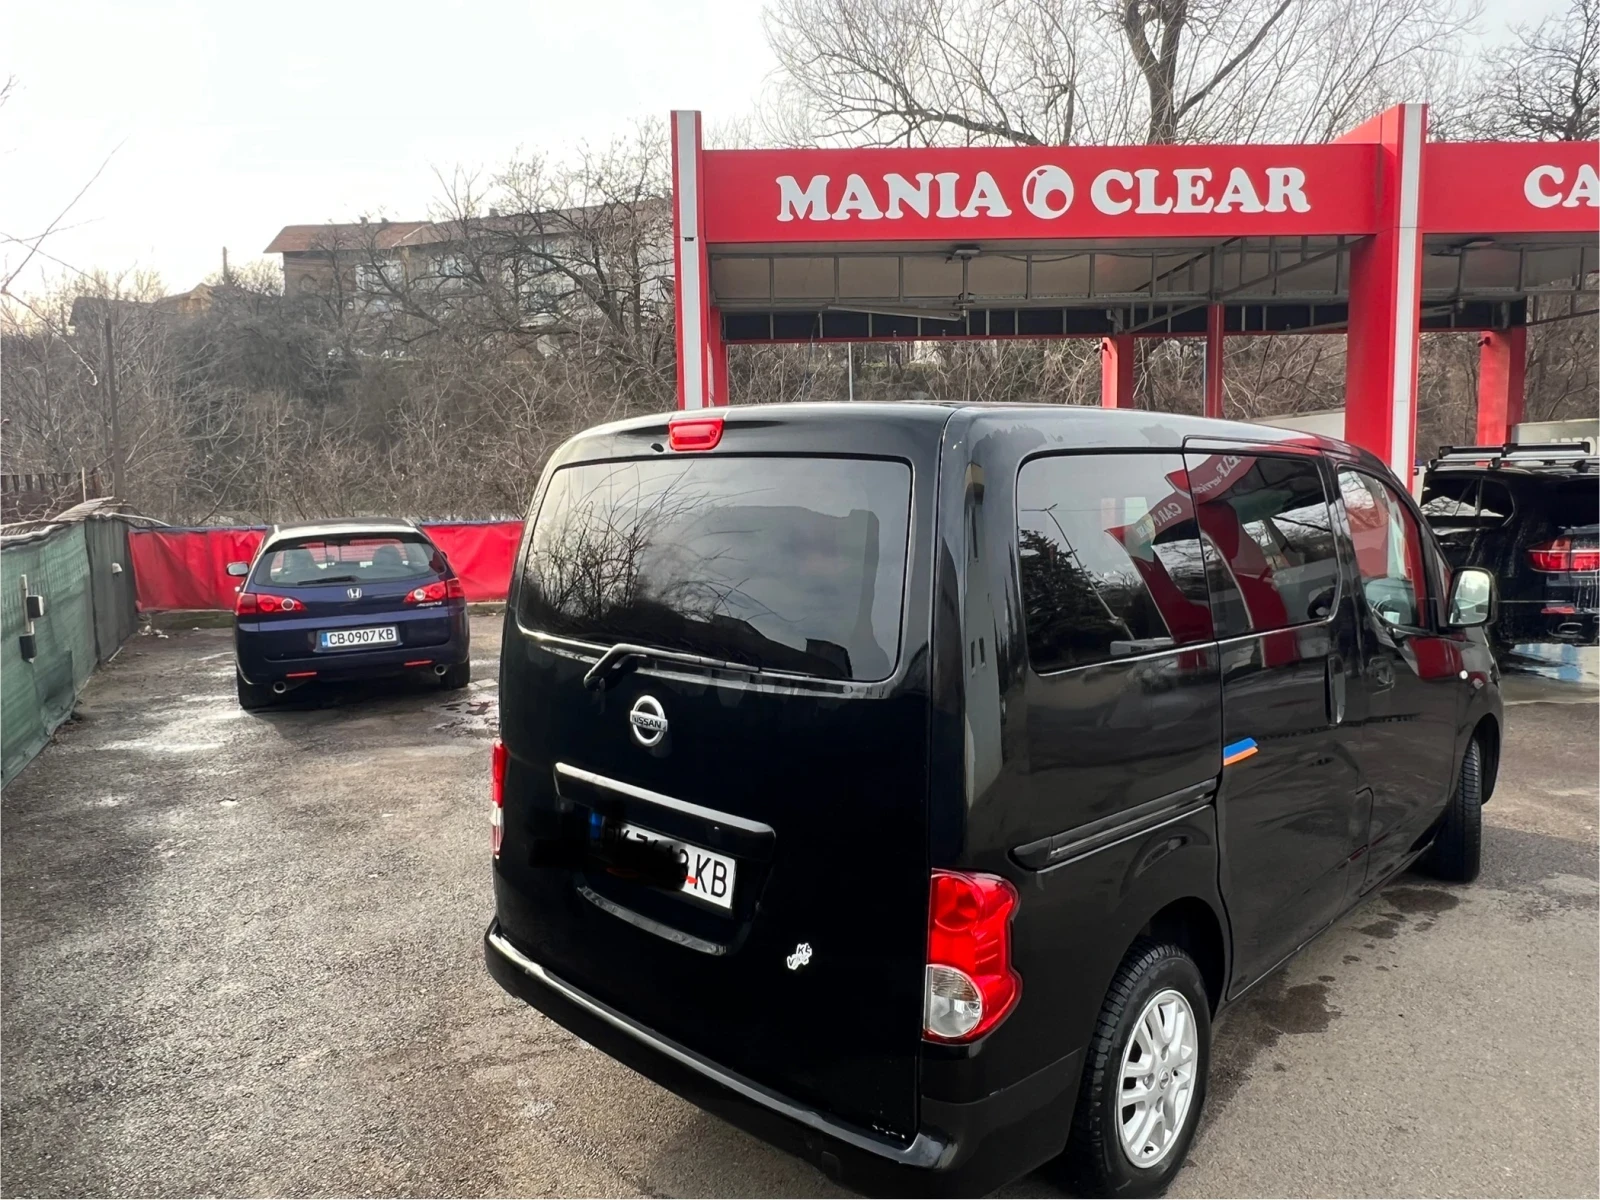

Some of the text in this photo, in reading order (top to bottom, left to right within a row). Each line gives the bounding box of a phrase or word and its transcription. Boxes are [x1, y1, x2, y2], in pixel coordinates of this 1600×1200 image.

[775, 167, 1311, 221] MANIA CLEAR
[347, 630, 376, 643] 0907
[378, 628, 394, 641] KB
